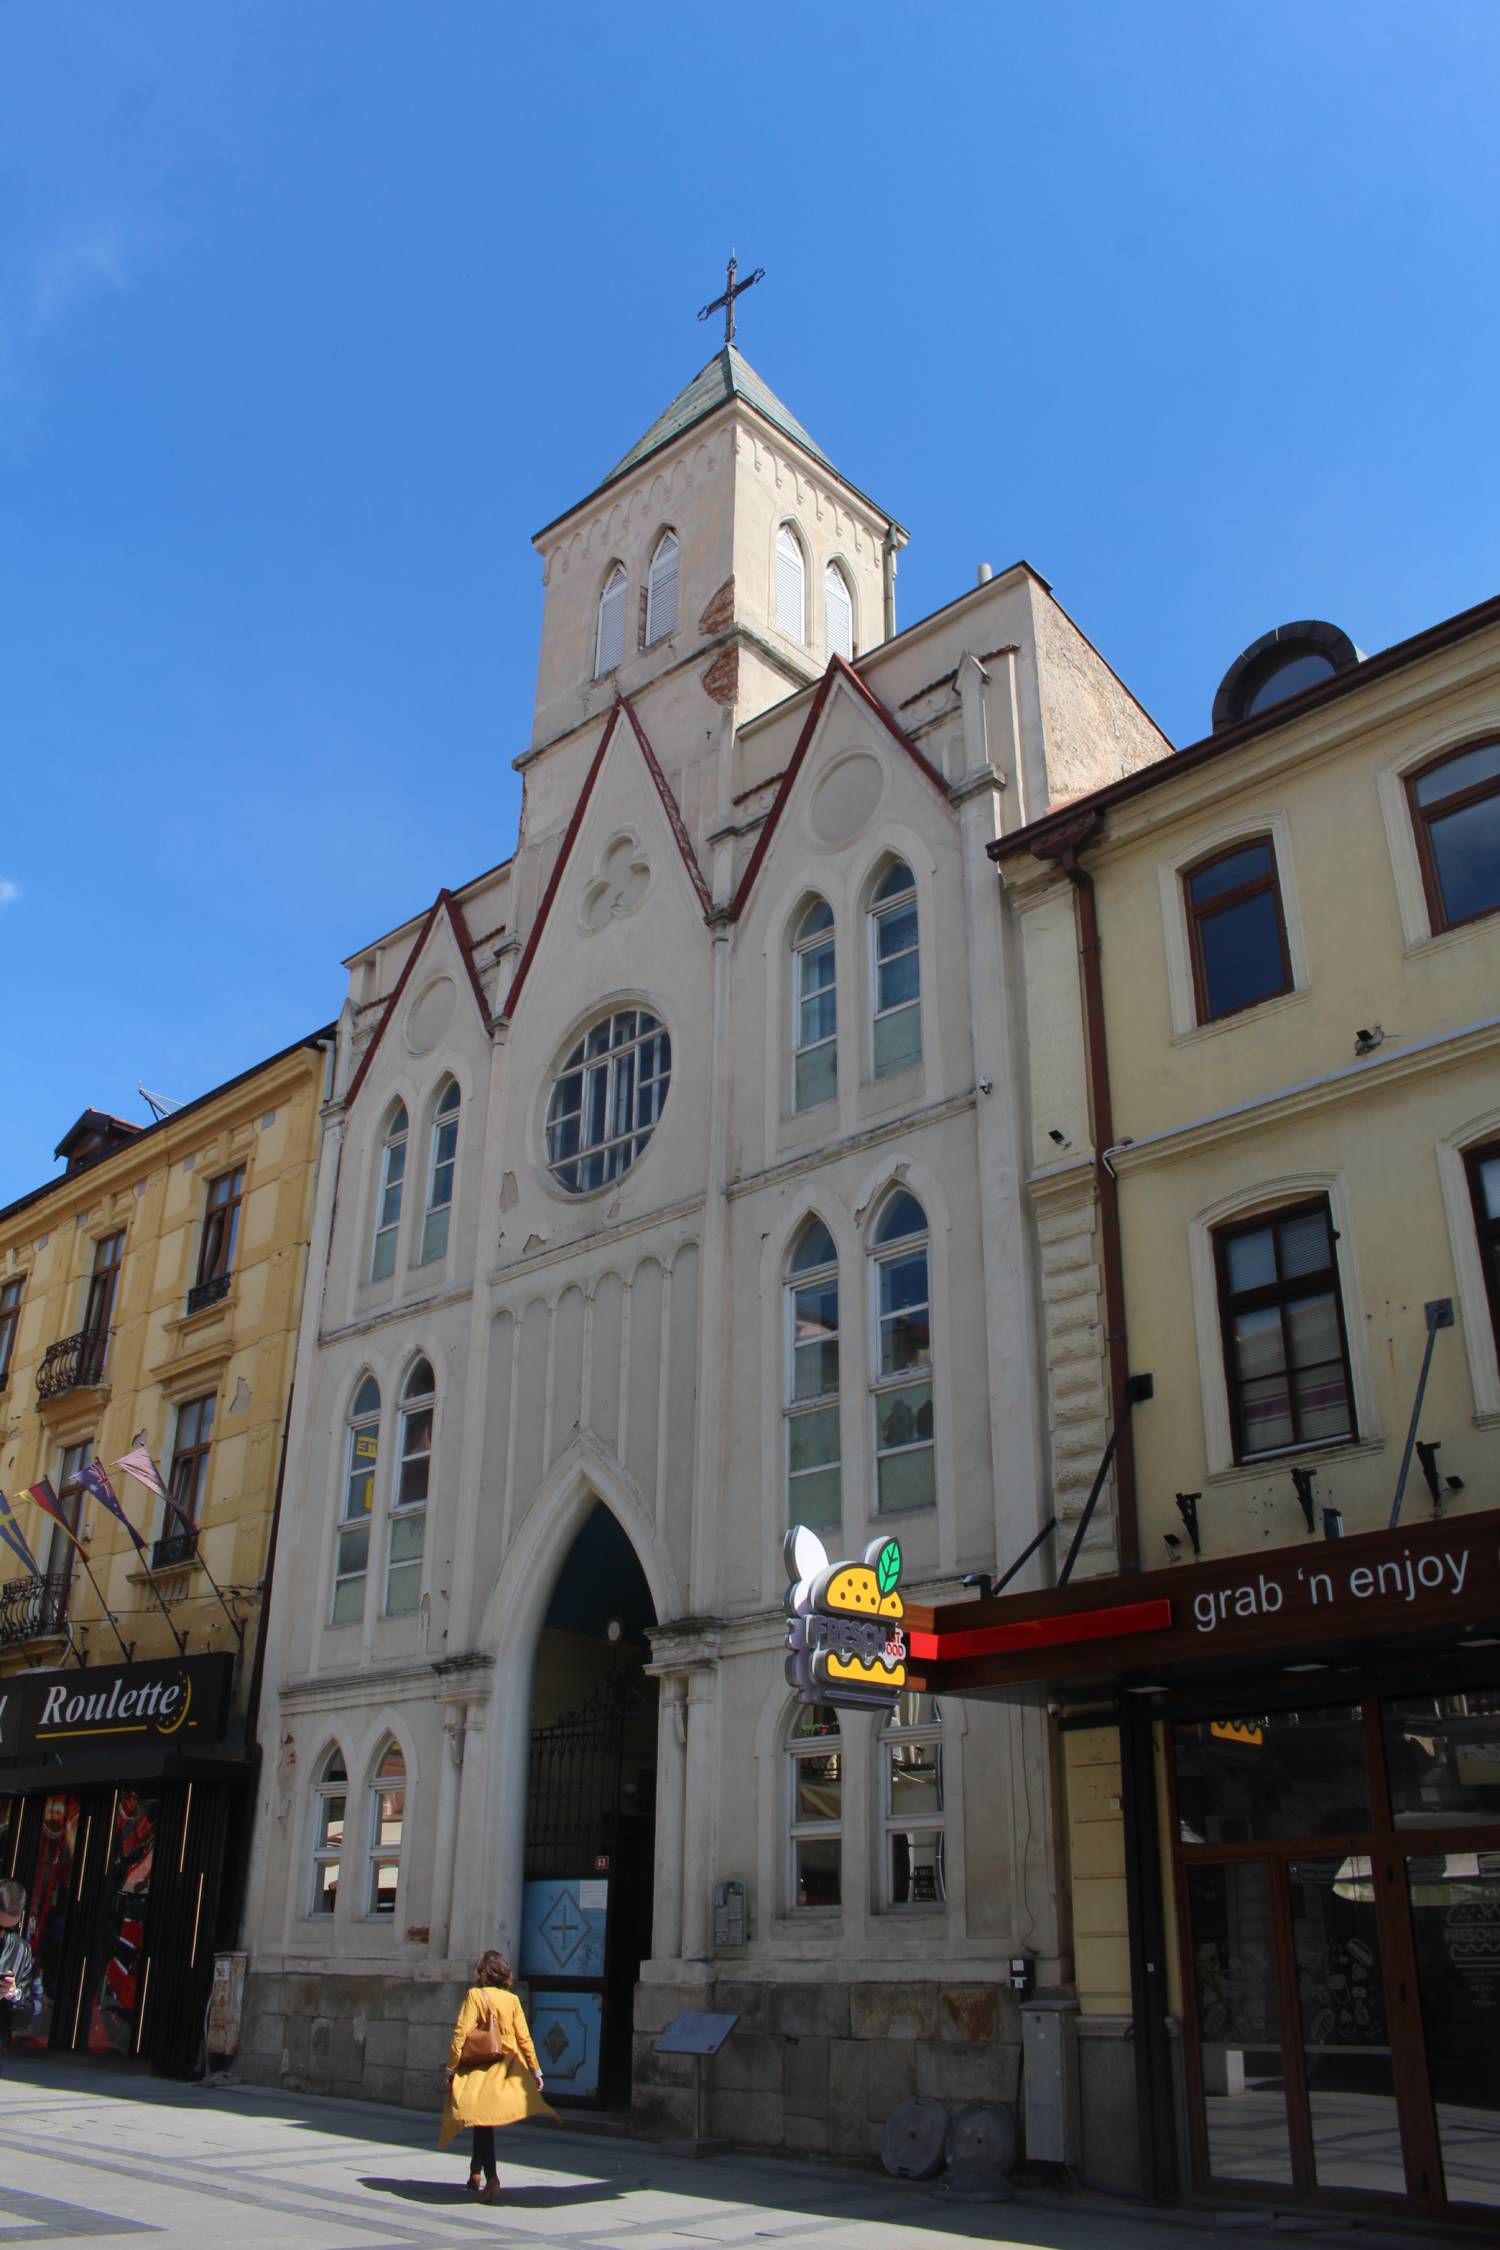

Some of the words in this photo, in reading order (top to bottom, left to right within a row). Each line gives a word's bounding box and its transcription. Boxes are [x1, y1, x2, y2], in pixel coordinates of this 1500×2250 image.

[1194, 1575, 1283, 1632] grab
[1350, 1550, 1469, 1601] enjoy
[38, 1678, 180, 1725] Roulette
